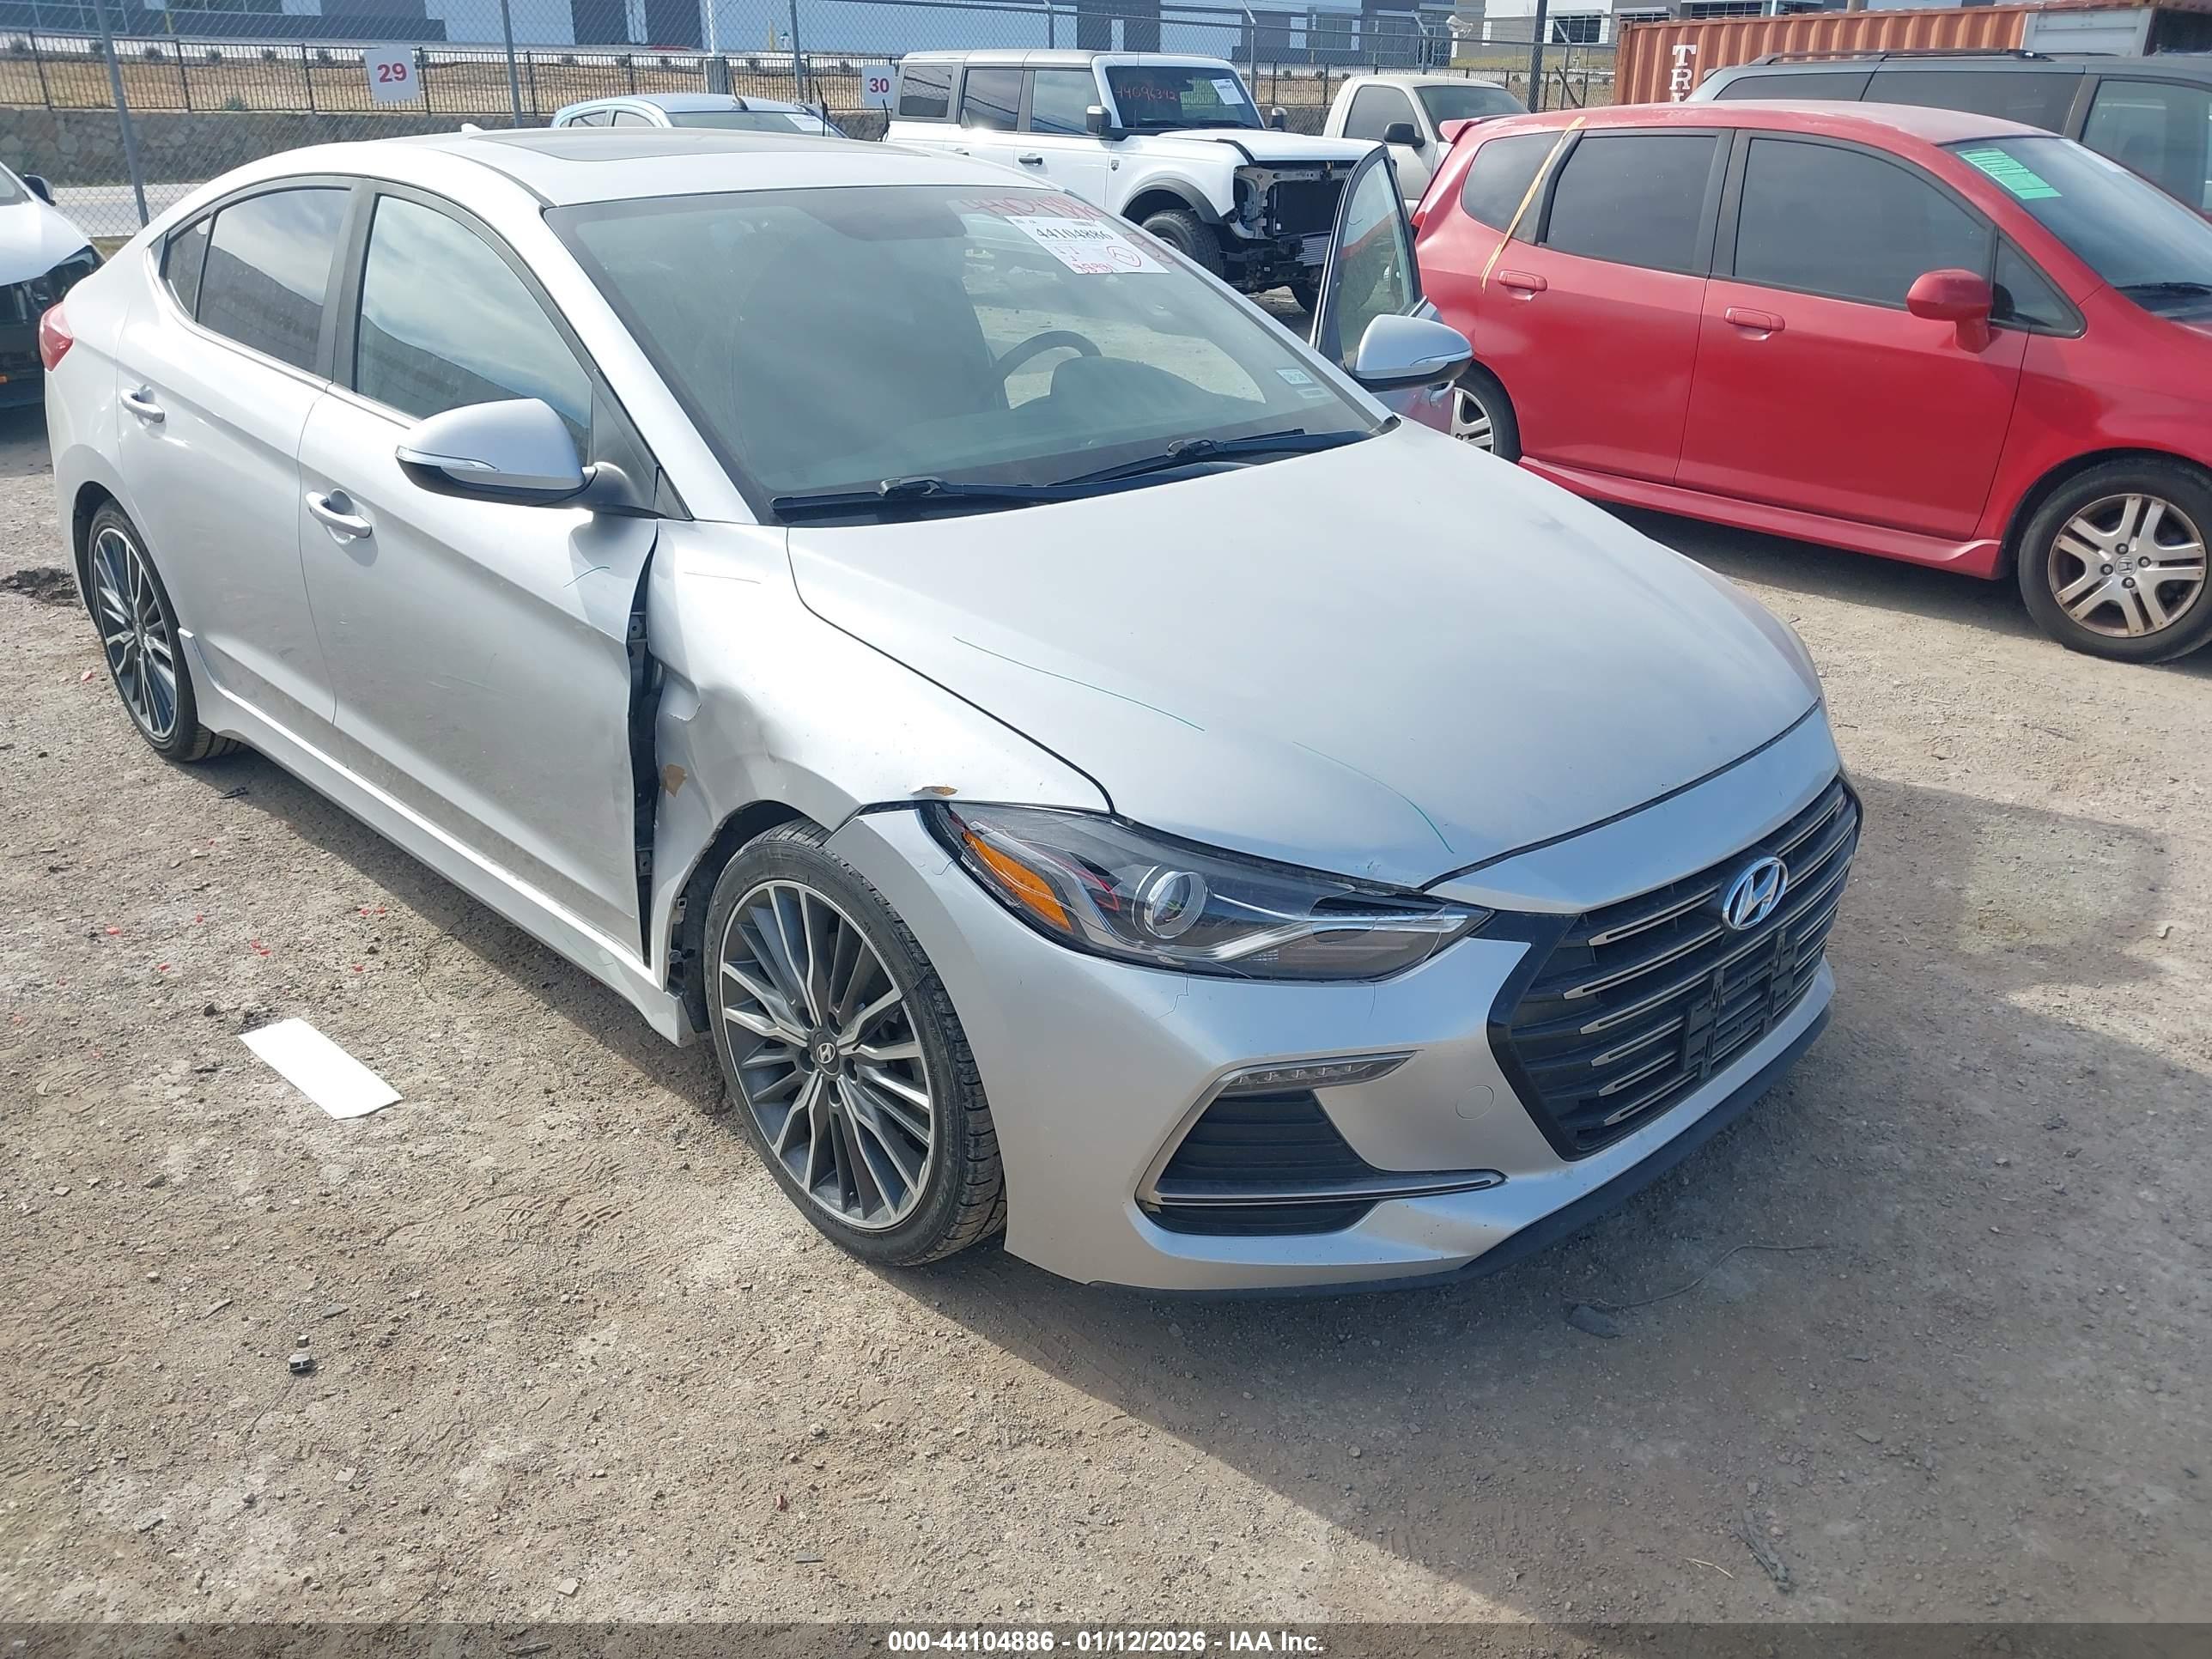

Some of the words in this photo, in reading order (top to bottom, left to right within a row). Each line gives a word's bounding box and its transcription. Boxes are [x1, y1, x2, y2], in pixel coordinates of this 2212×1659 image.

[377, 62, 407, 83] 29
[868, 77, 890, 94] 30
[1036, 227, 1114, 240] 44104886
